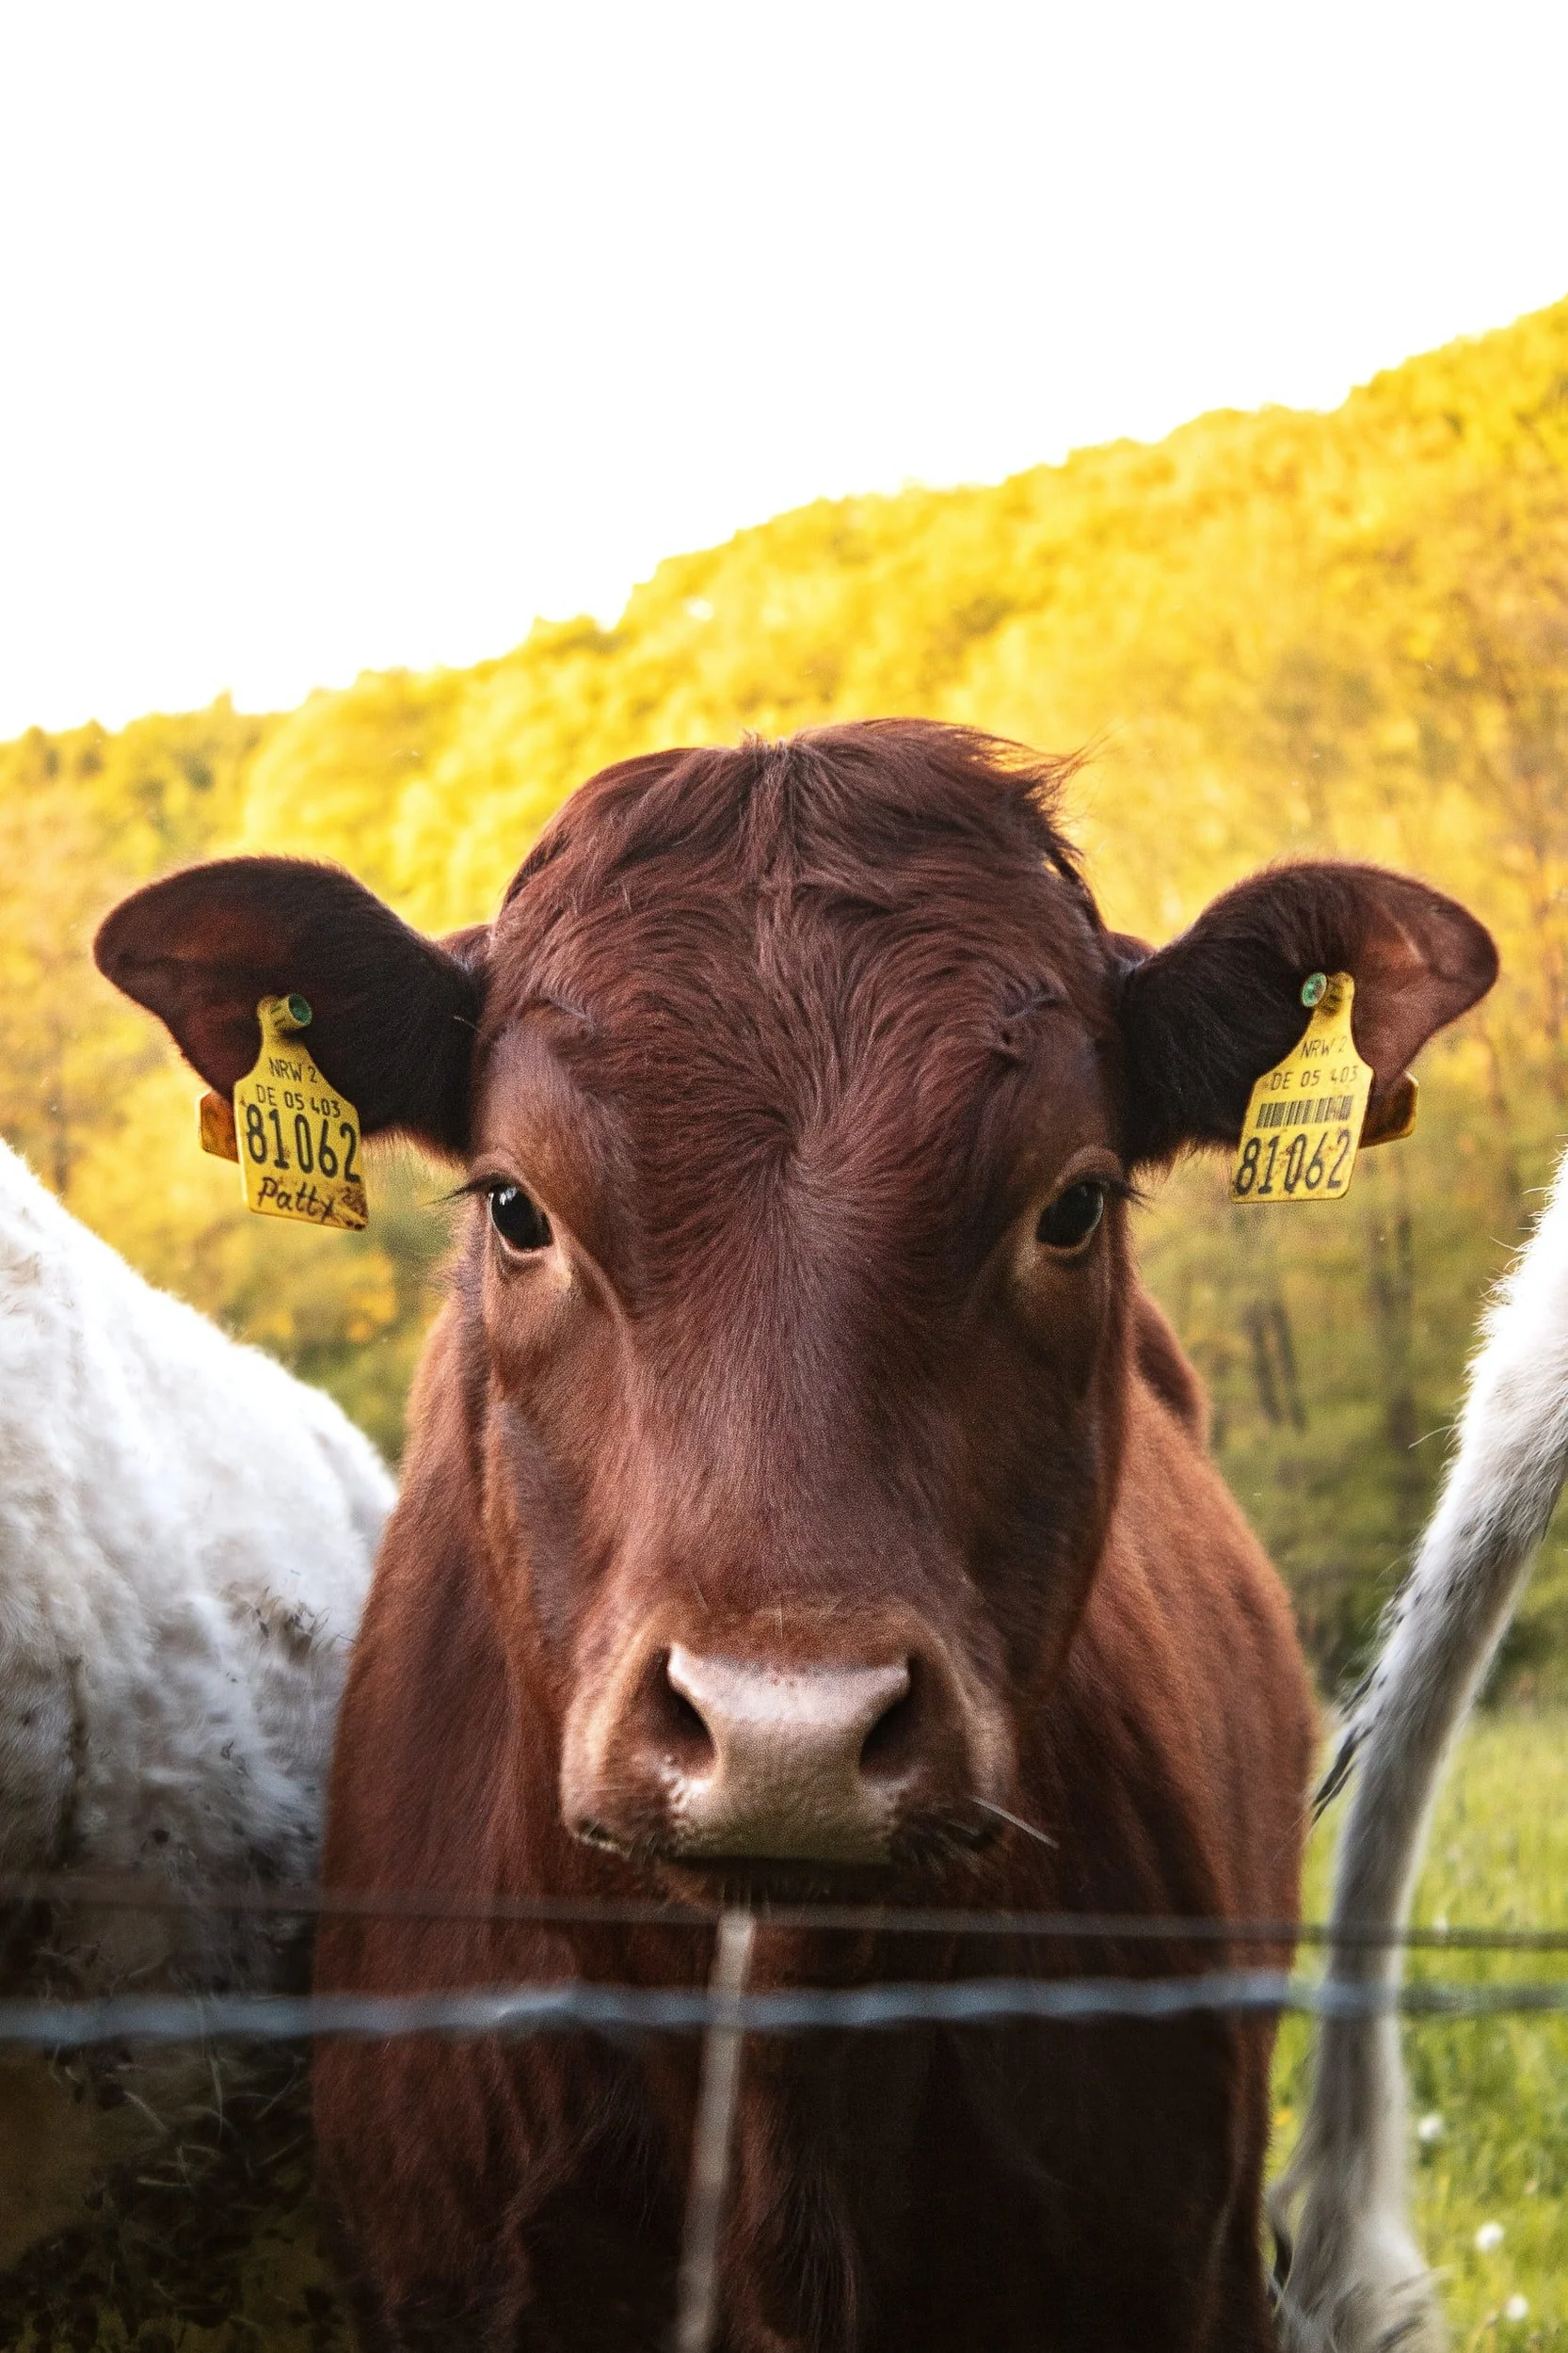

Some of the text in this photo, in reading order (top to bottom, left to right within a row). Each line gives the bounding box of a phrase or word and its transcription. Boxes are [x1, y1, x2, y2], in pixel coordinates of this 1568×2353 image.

[268, 1056, 318, 1083] NRW 2
[1271, 1065, 1358, 1091] DE 05 403
[255, 1083, 342, 1118] DE 05 403
[246, 1103, 361, 1183] 81062
[1234, 1128, 1352, 1195] 81062
